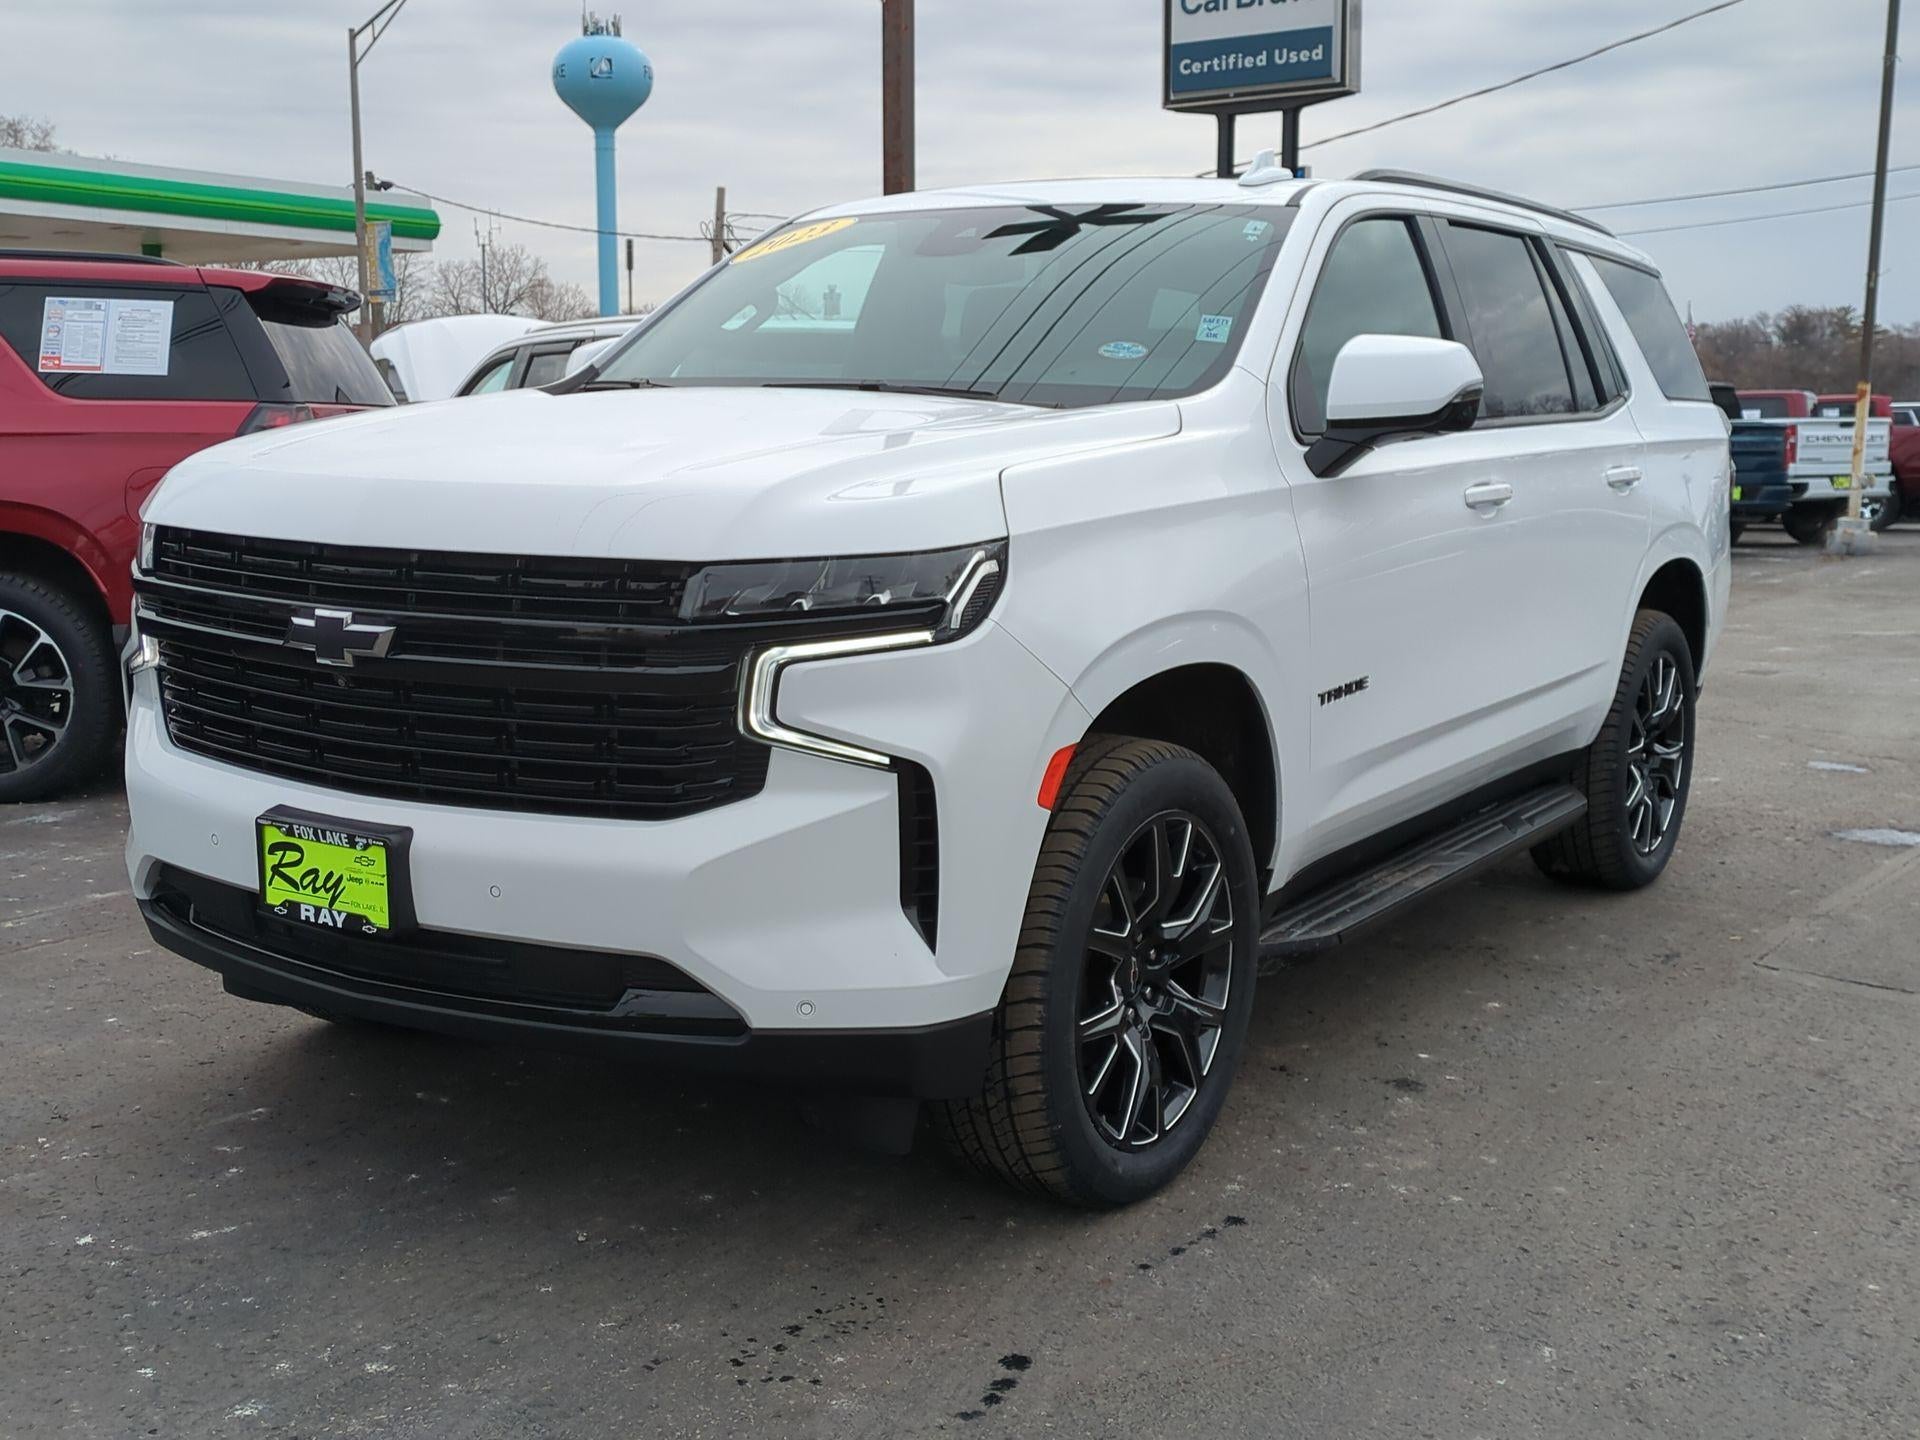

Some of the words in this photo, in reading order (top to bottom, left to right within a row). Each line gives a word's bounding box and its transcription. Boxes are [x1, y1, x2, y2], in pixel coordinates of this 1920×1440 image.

[1180, 50, 1267, 75] Certified
[1274, 44, 1323, 65] Used
[1806, 434, 1885, 443] CHEVRET
[1317, 675, 1370, 707] TAHOE
[293, 824, 317, 842] FOX
[318, 829, 350, 848] LAKE
[268, 841, 346, 909] Ray
[346, 873, 364, 886] Jeep
[300, 904, 347, 929] RAY
